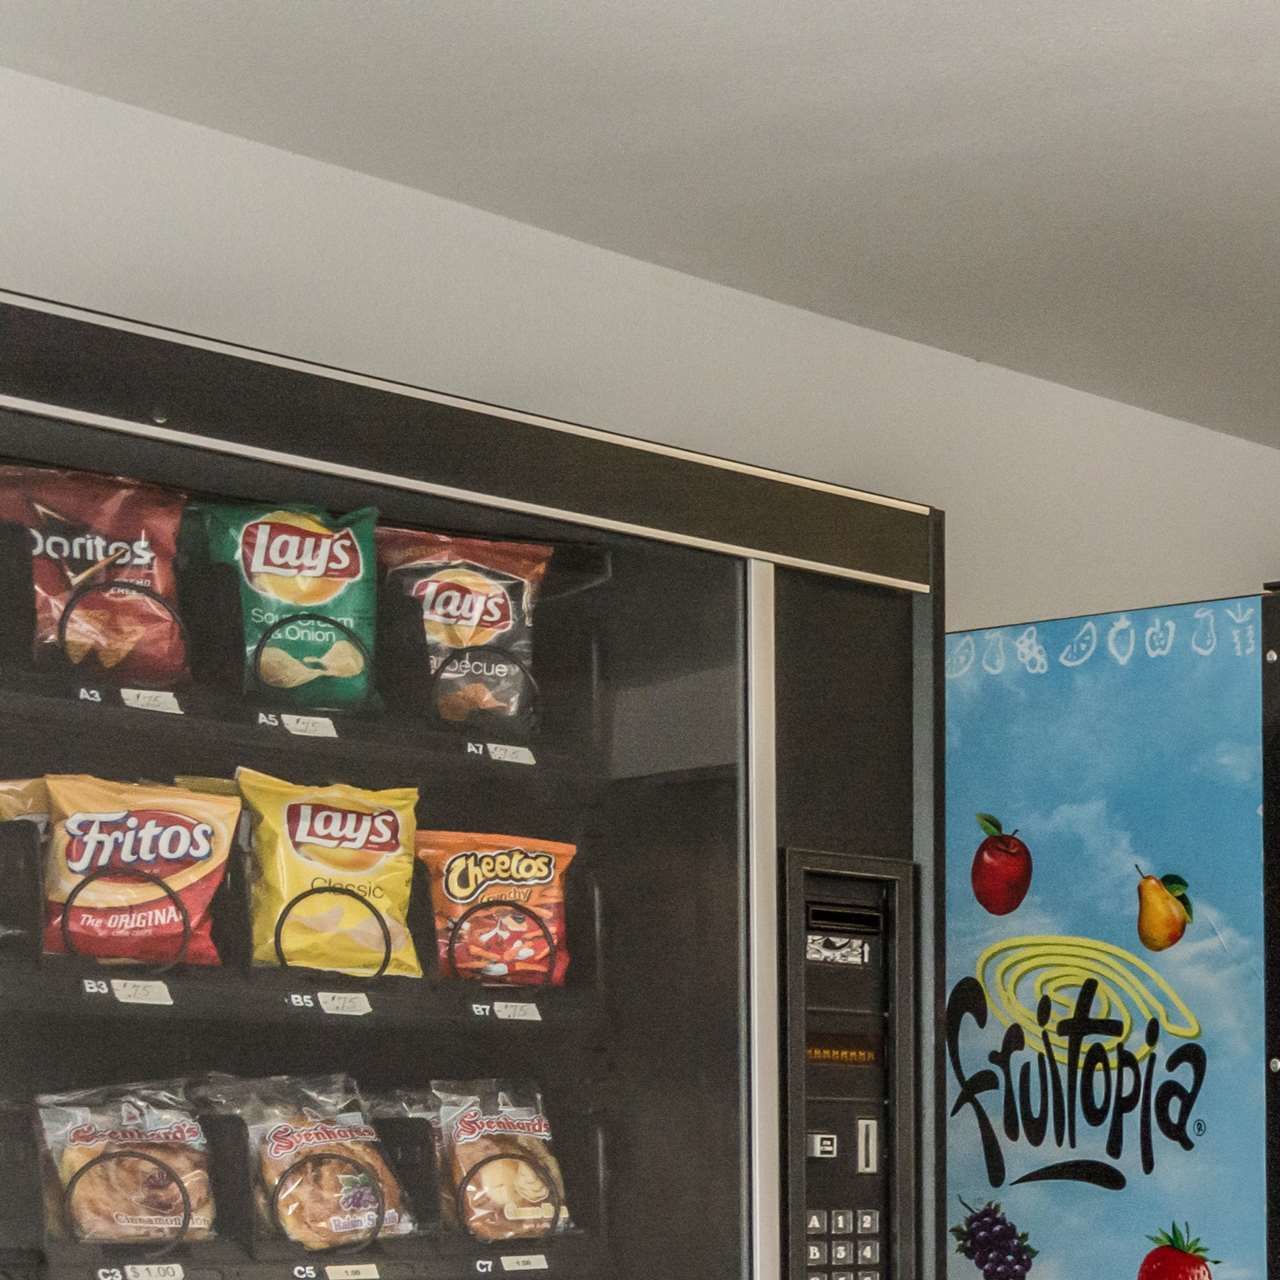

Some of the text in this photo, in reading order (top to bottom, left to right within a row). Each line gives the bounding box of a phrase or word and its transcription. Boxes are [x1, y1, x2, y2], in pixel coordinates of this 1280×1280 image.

[251, 523, 351, 577] Lay's
[285, 625, 336, 642] Onion
[79, 688, 101, 702] A3
[258, 712, 279, 726] A5
[467, 742, 483, 755] A7
[295, 804, 394, 849] Lay's
[66, 810, 213, 873] Fritos
[446, 850, 553, 900] Cheetos
[79, 913, 102, 928] The
[83, 979, 108, 994] B3
[290, 994, 314, 1007] B5
[472, 1004, 490, 1016] B7
[808, 1216, 871, 1228] A 1 2
[809, 1246, 871, 1259] B 3 4
[293, 1266, 317, 1278] C5
[476, 1260, 493, 1272] C7
